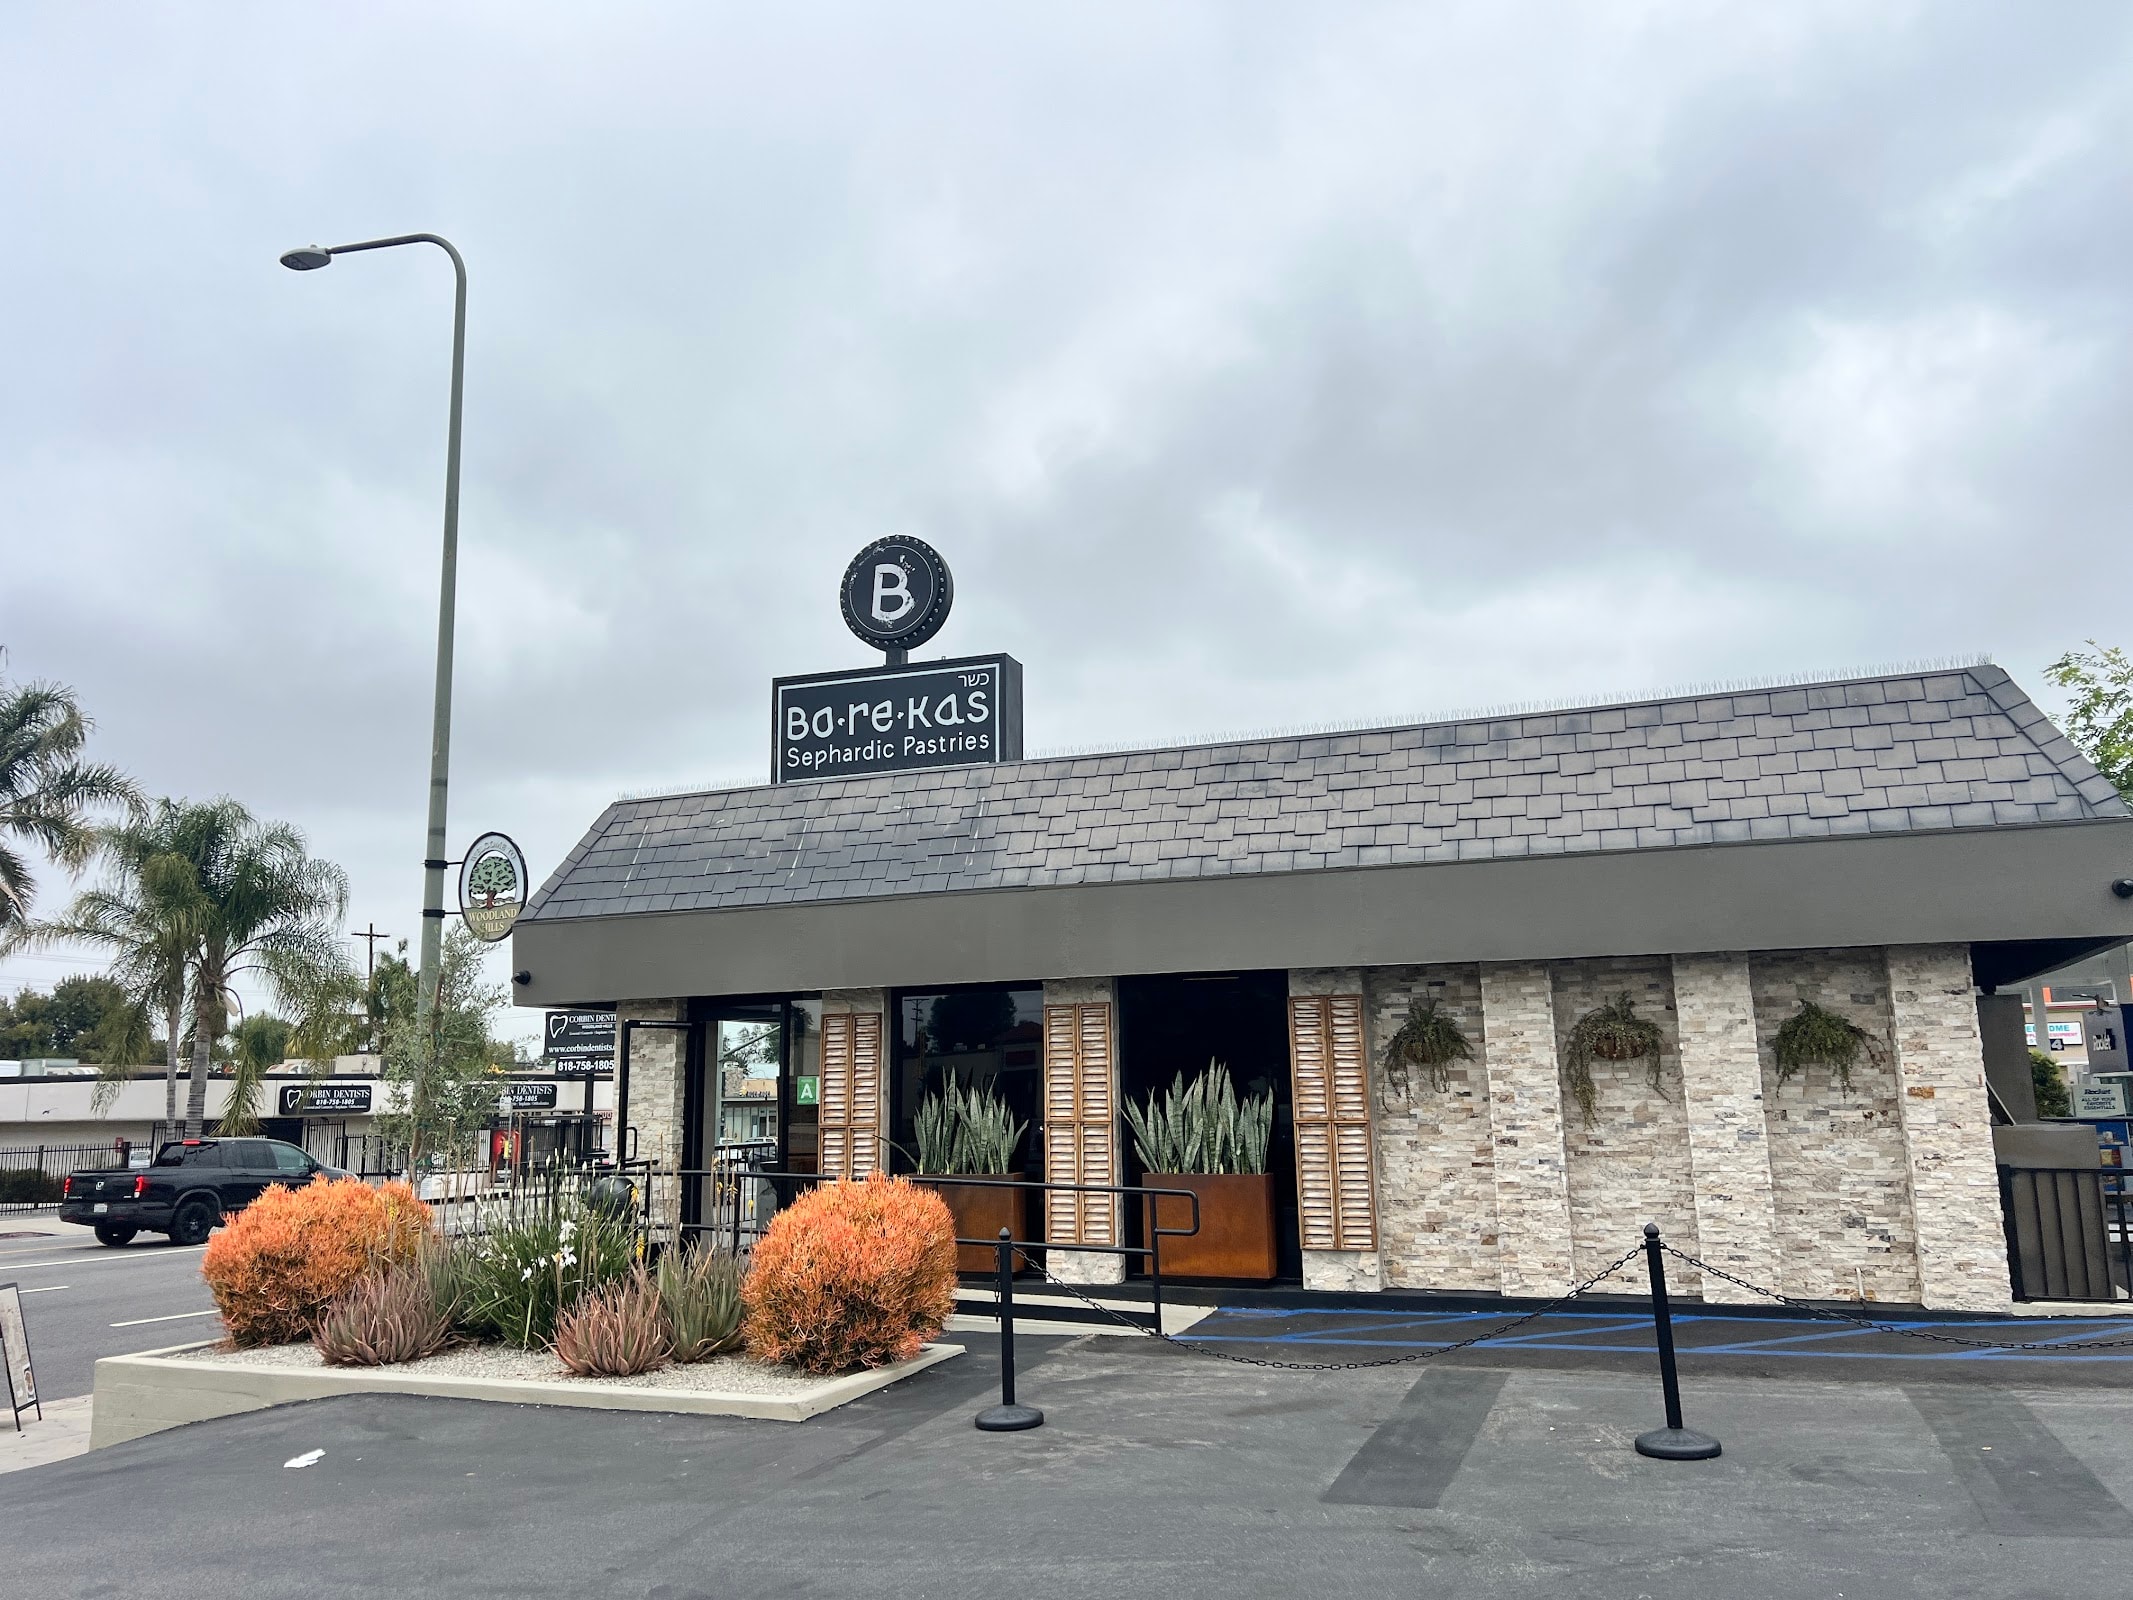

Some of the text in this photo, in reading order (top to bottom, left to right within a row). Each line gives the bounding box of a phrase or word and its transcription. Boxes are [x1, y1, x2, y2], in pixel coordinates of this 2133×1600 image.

[871, 563, 915, 623] B
[957, 673, 990, 688] כשר
[786, 731, 990, 771] Sephardic Pastries
[468, 908, 517, 922] WOODLAND
[569, 1013, 616, 1024] CORBIN DENTI
[2051, 1039, 2063, 1050] 4
[557, 1059, 615, 1072] 818-758-1805
[301, 1089, 370, 1099] CORBIN DENTISTS
[517, 1085, 552, 1095] DENTISTS
[800, 1082, 814, 1100] A
